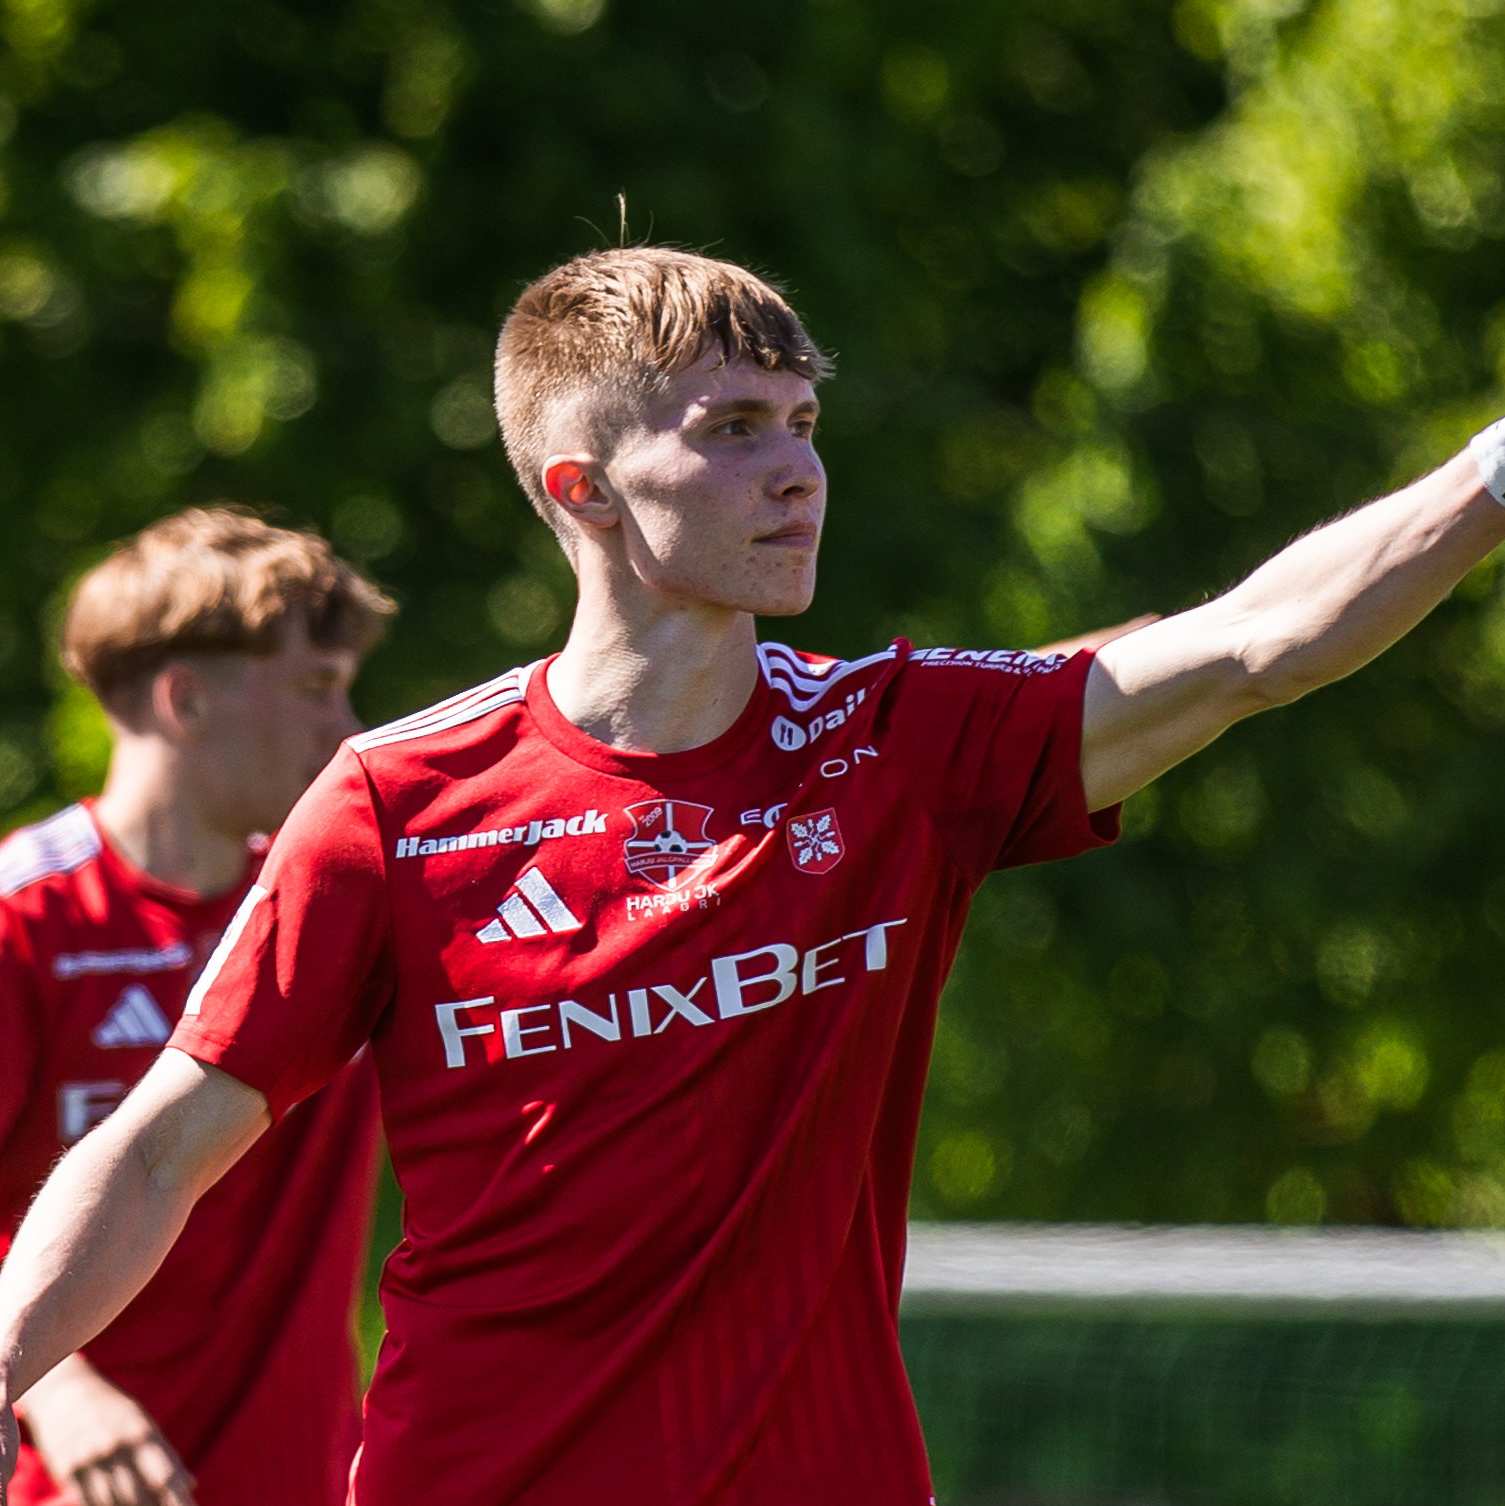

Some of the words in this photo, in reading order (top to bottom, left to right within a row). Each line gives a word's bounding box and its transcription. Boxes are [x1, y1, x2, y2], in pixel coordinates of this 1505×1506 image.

[809, 687, 866, 744] Dail
[626, 889, 691, 911] HARJU
[694, 882, 721, 900] JK
